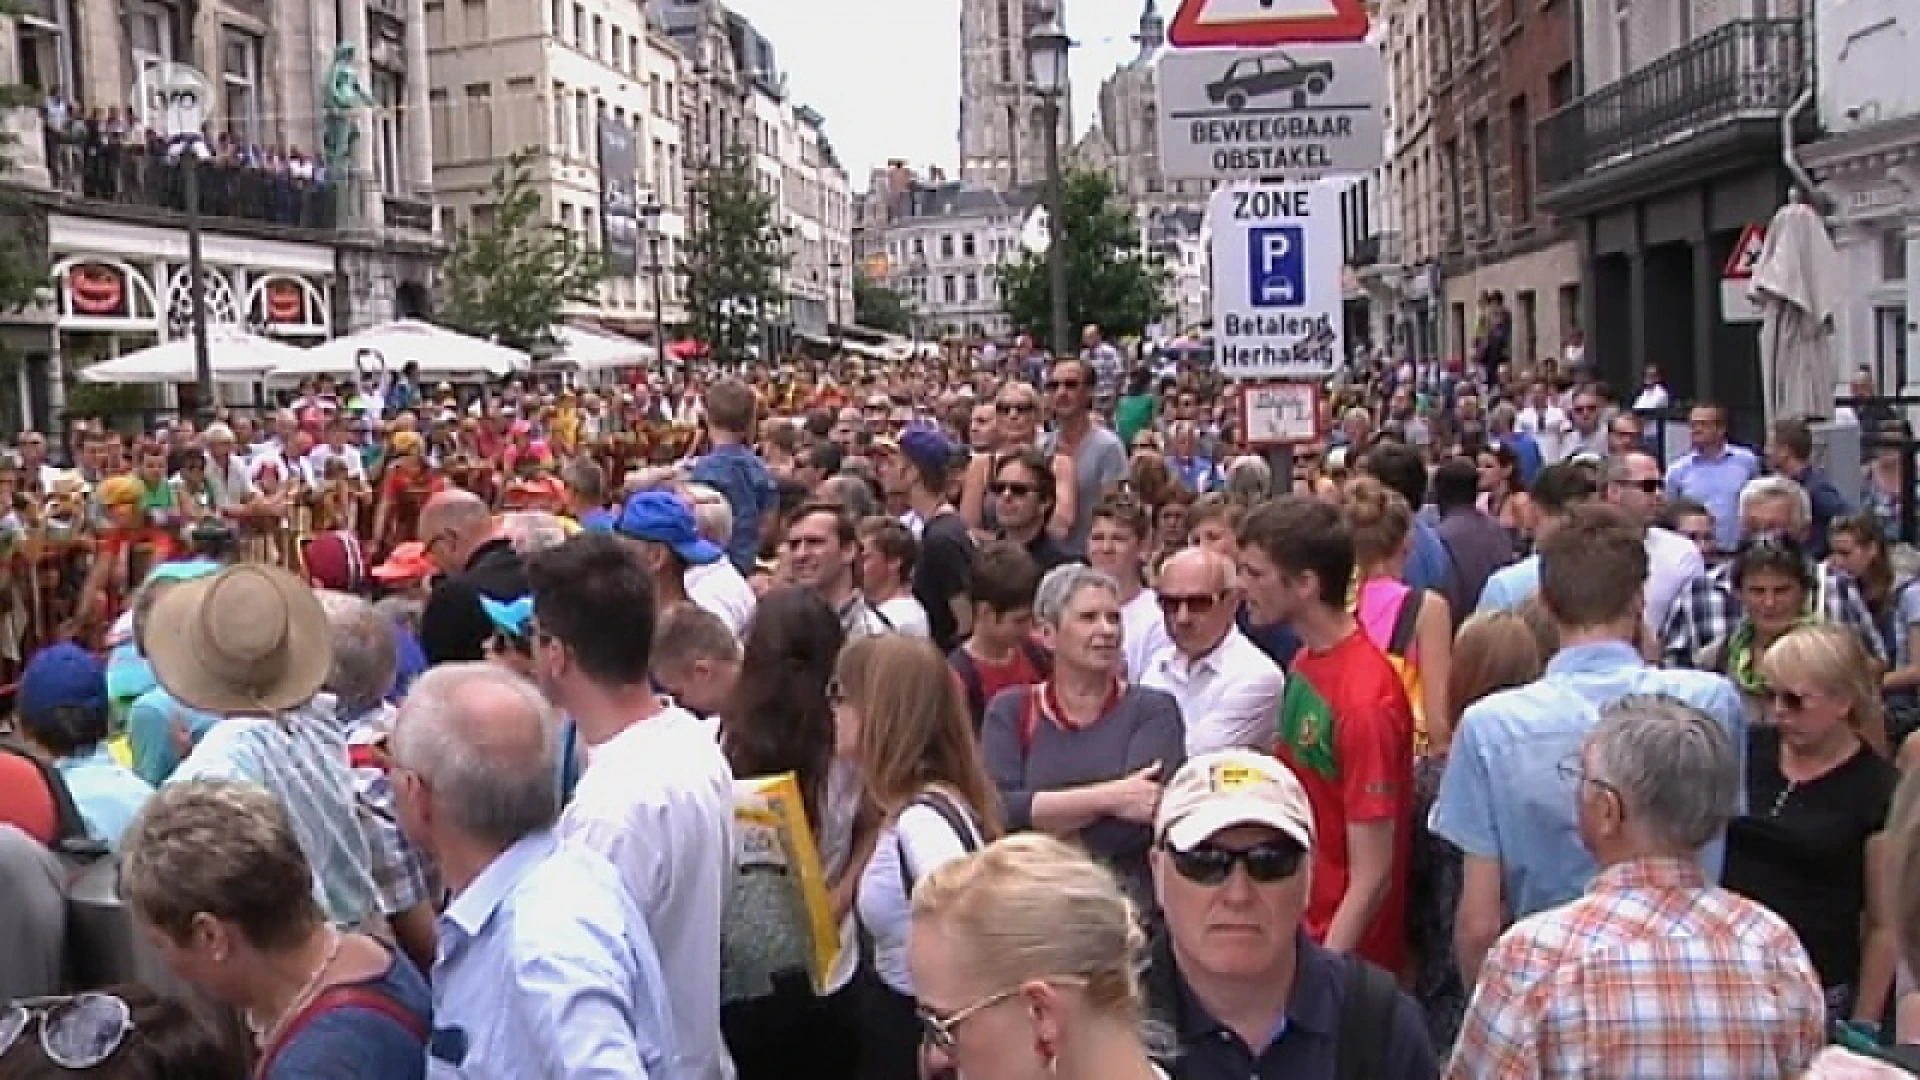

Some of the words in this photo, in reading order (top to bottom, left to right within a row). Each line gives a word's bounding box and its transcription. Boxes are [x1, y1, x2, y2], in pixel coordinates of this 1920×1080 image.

[1191, 117, 1352, 143] BEWEEGBAAR
[1213, 145, 1332, 170] OBSTAKEL
[1234, 191, 1309, 218] ZONE
[1261, 234, 1290, 273] P
[1225, 312, 1332, 336] Betalend
[1223, 343, 1332, 369] Herhalg
